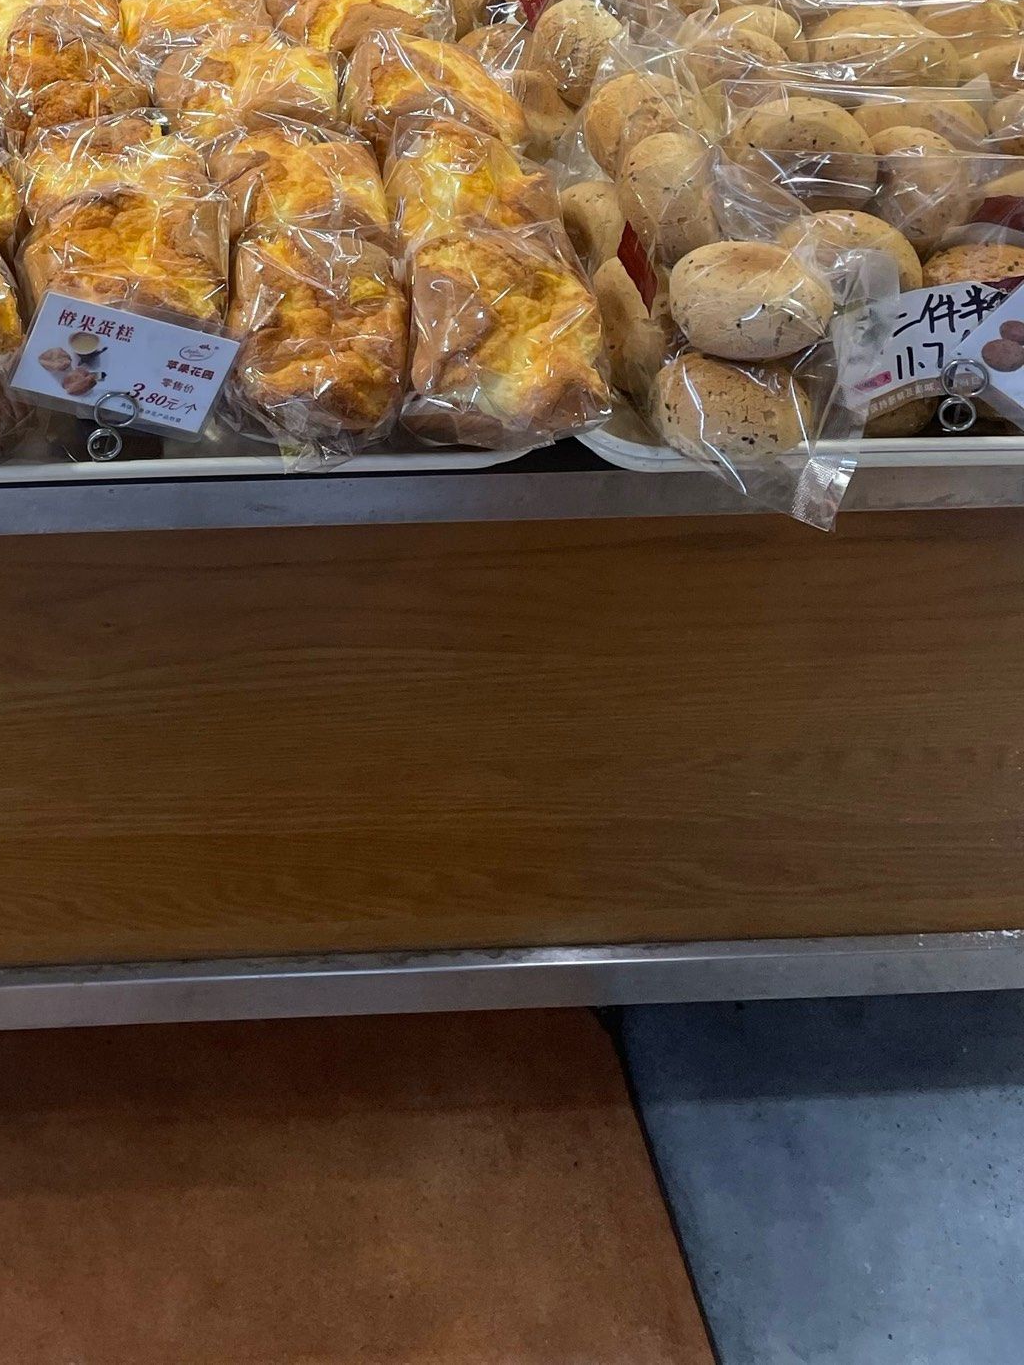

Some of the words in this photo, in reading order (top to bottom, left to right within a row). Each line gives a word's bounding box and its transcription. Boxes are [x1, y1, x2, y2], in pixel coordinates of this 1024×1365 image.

[166, 359, 215, 381] 苹果花园
[161, 377, 194, 395] 零售价
